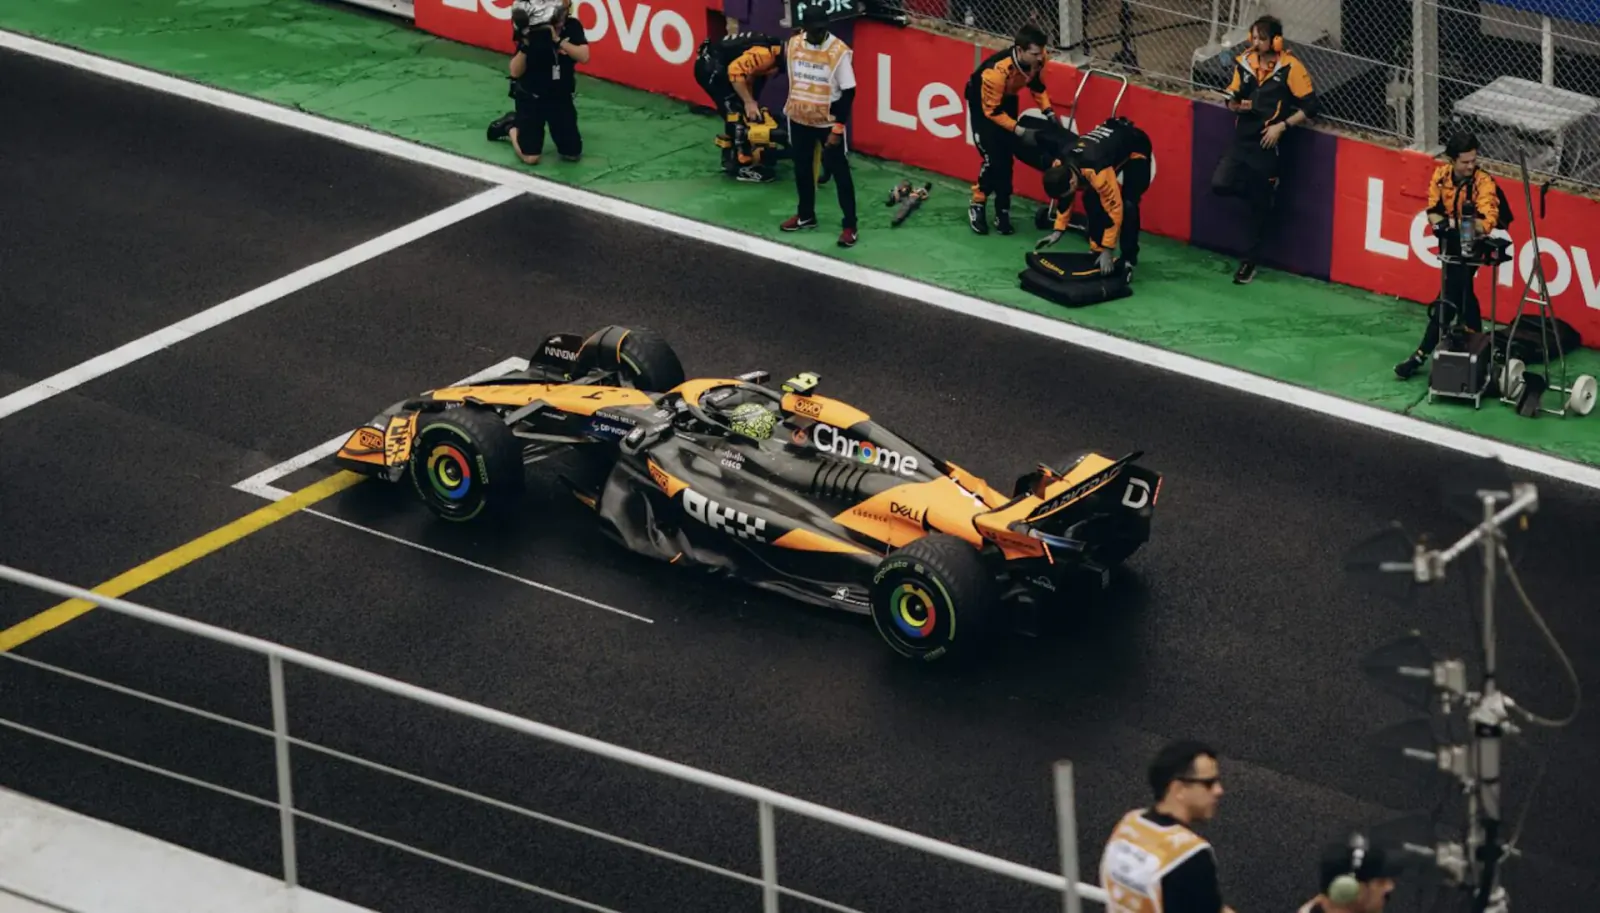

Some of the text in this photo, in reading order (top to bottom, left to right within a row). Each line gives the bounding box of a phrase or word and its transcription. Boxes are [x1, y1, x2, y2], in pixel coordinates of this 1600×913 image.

[813, 423, 918, 477] Chrome
[1121, 476, 1151, 509] D
[890, 501, 921, 523] DELL
